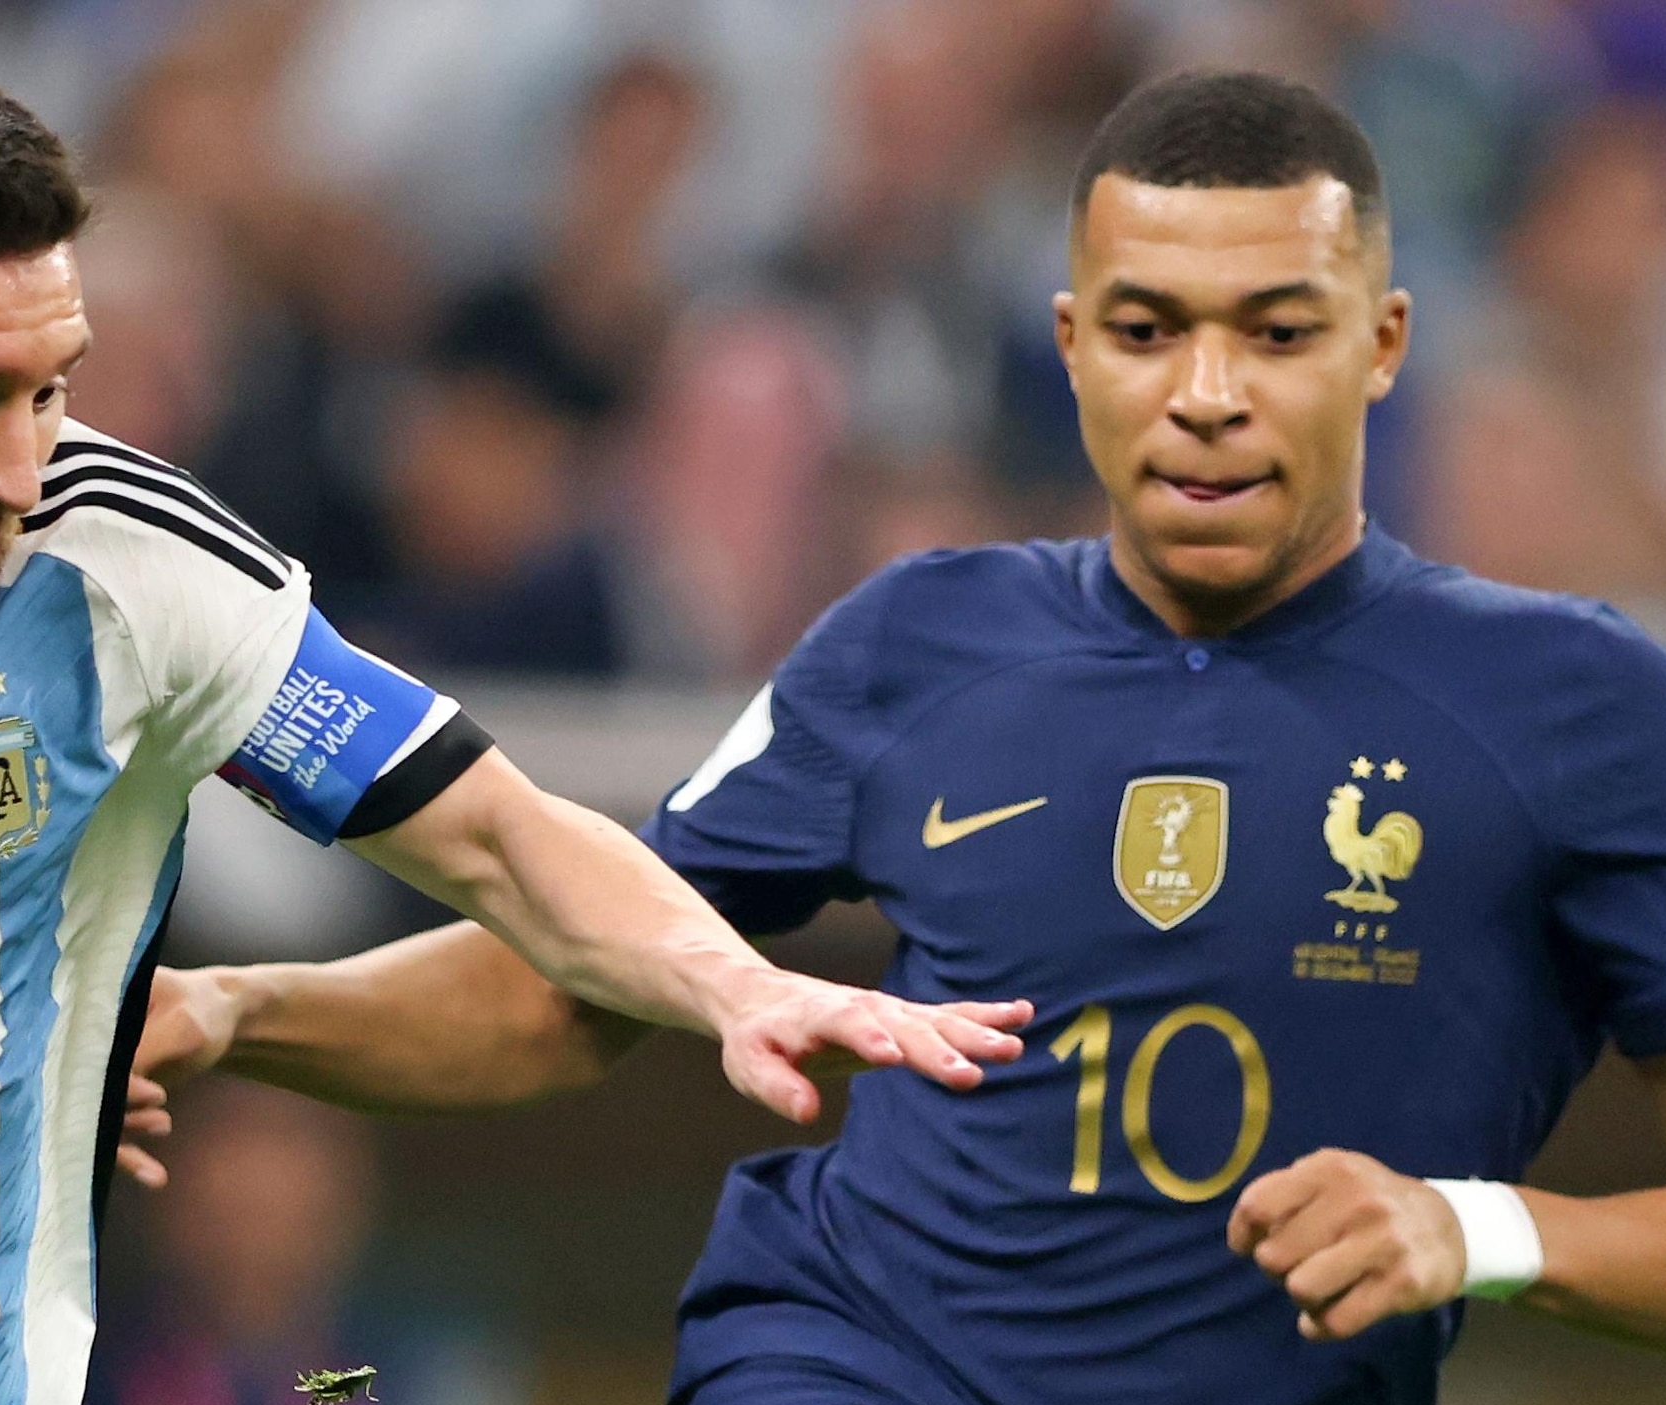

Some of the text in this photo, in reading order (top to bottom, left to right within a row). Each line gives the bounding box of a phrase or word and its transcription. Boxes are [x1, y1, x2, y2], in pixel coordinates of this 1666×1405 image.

[258, 680, 346, 773] UNITES
[293, 694, 377, 789] the World
[1048, 1003, 1272, 1203] 10
